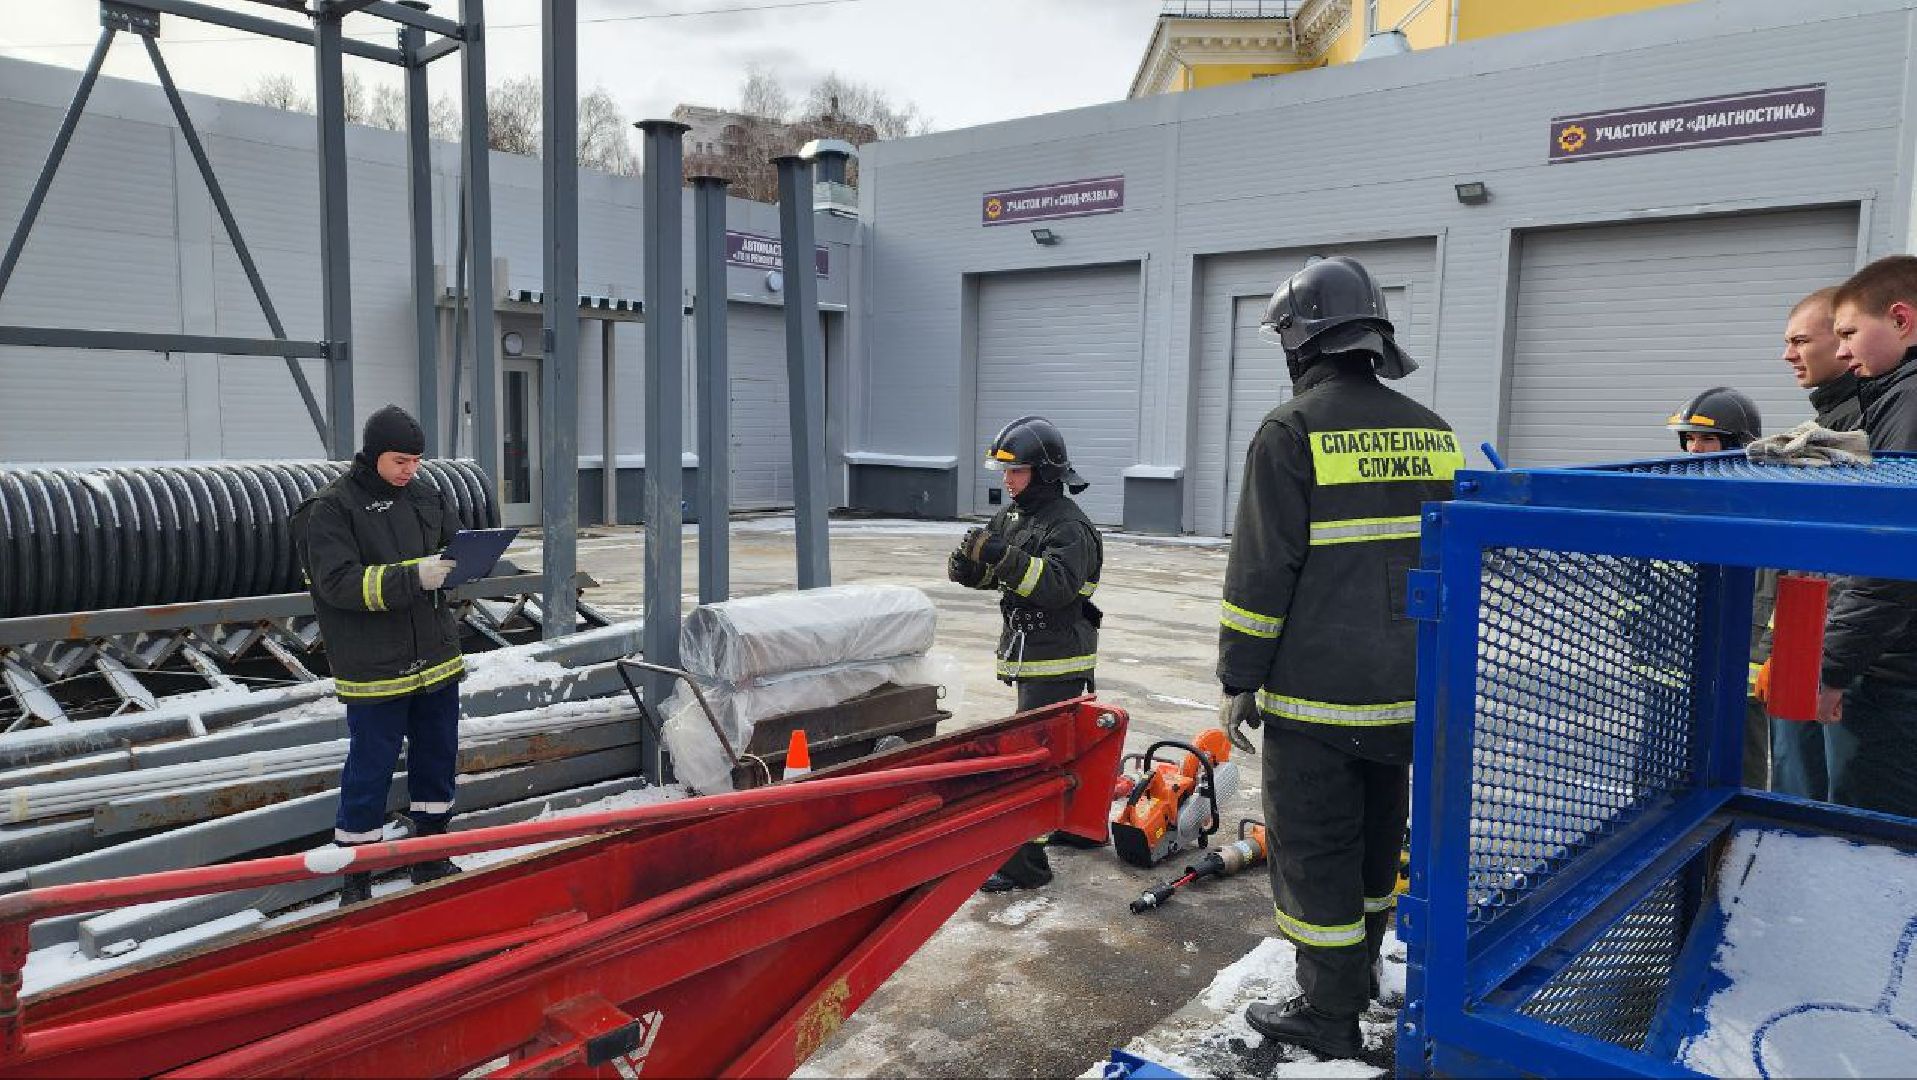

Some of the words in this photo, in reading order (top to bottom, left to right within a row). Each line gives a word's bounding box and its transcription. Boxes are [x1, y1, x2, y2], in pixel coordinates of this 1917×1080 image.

[1595, 120, 1657, 142] УЧАСТОК
[1659, 117, 1684, 135] №2
[1686, 103, 1816, 132] «ДИАГНОСТИКА»
[1006, 198, 1040, 212] УЧАСТОК
[741, 238, 782, 254] АВТОМАСТ
[1321, 431, 1456, 454] СПАСАТЕЛЬНАЯ
[1358, 455, 1434, 478] СЛУЖБА
